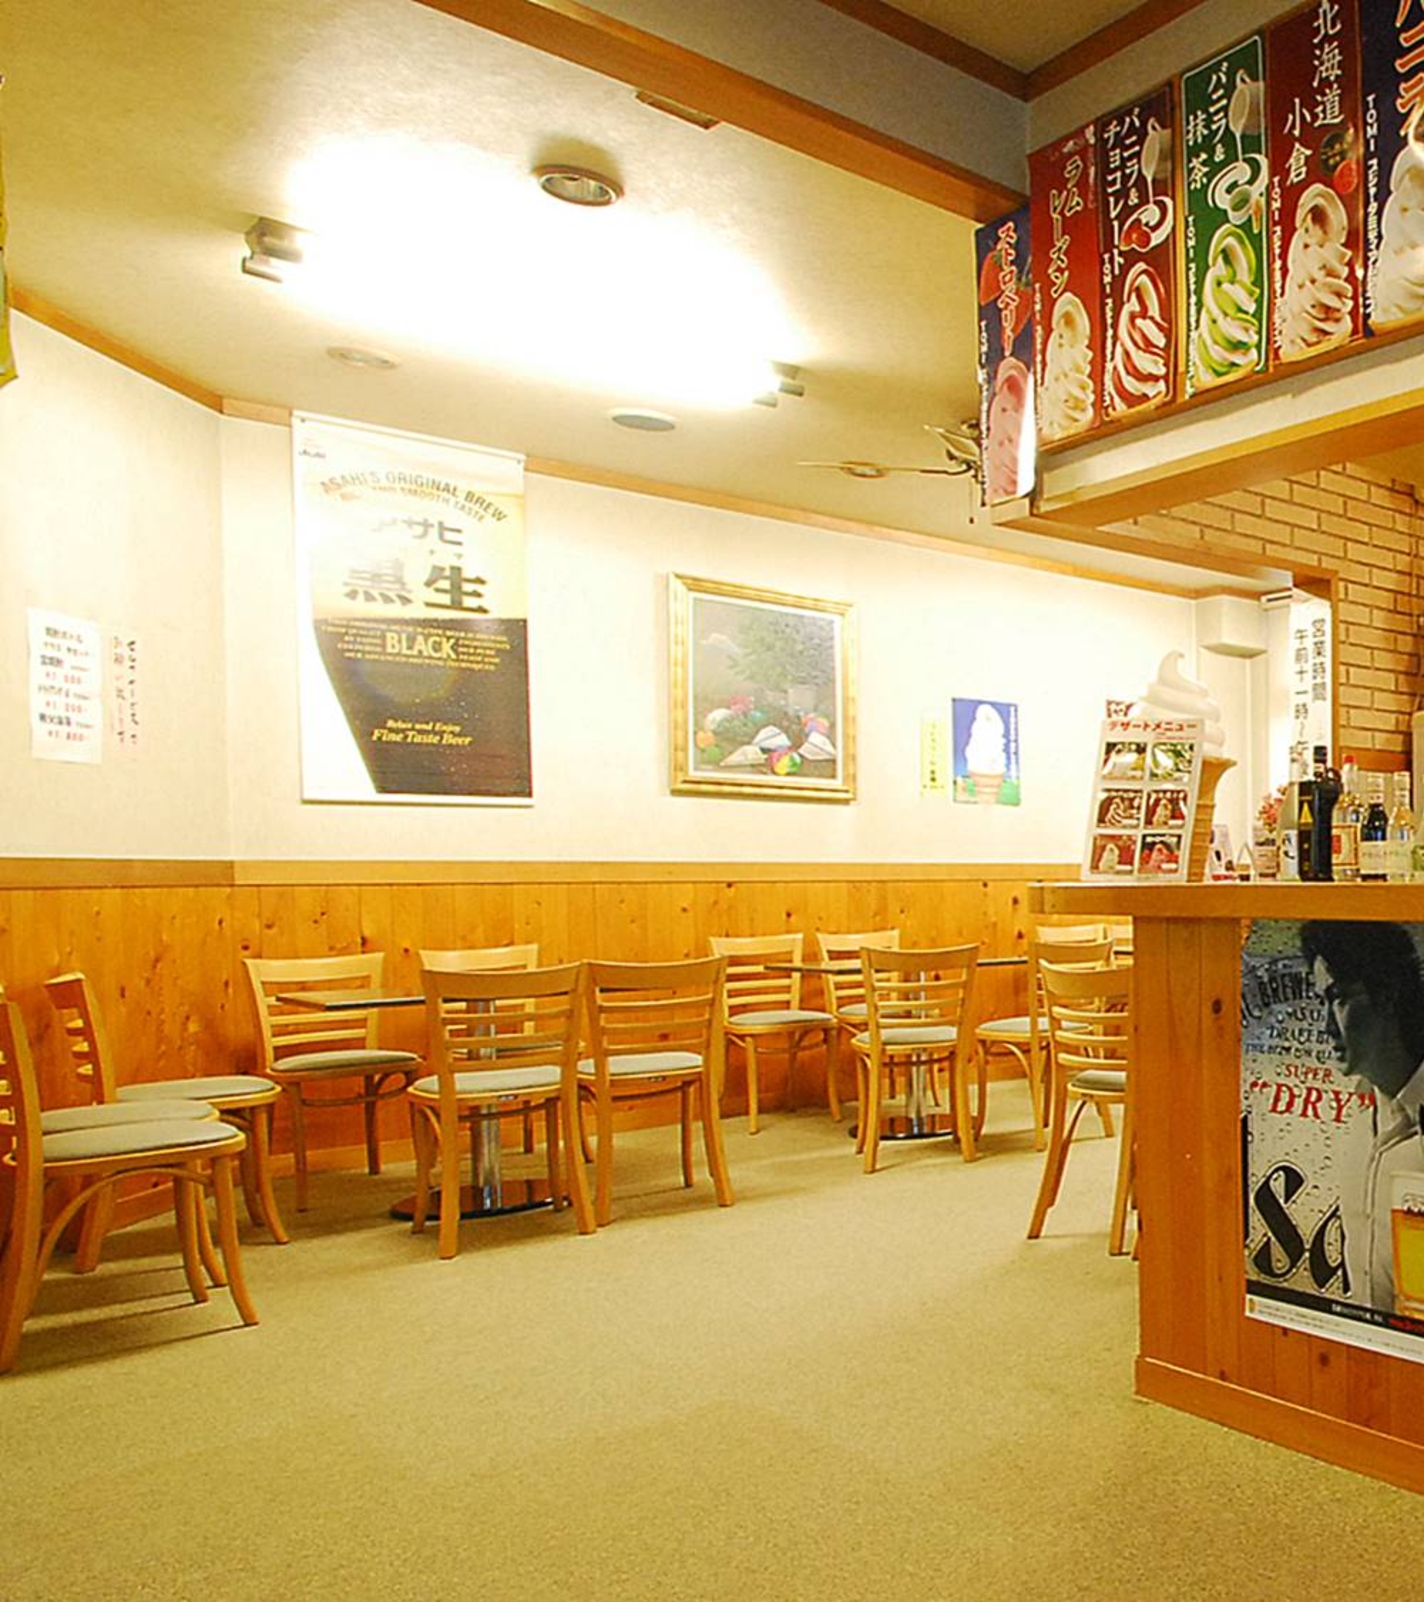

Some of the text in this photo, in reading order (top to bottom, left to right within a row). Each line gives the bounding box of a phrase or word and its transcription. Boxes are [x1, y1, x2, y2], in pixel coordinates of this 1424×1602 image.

[1312, 0, 1344, 127] 北海道
[1186, 111, 1209, 190] 抹茶
[1284, 98, 1312, 187] 小倉
[1103, 121, 1124, 276] チョコレート
[996, 222, 1019, 357] ストロベリー
[385, 471, 460, 498] ORIGINAL
[464, 490, 507, 522] BREW
[343, 557, 490, 614] 黒生
[385, 632, 457, 660] BLACK
[371, 729, 473, 745] Fine Taste Beer
[1284, 1063, 1334, 1084] SUPER
